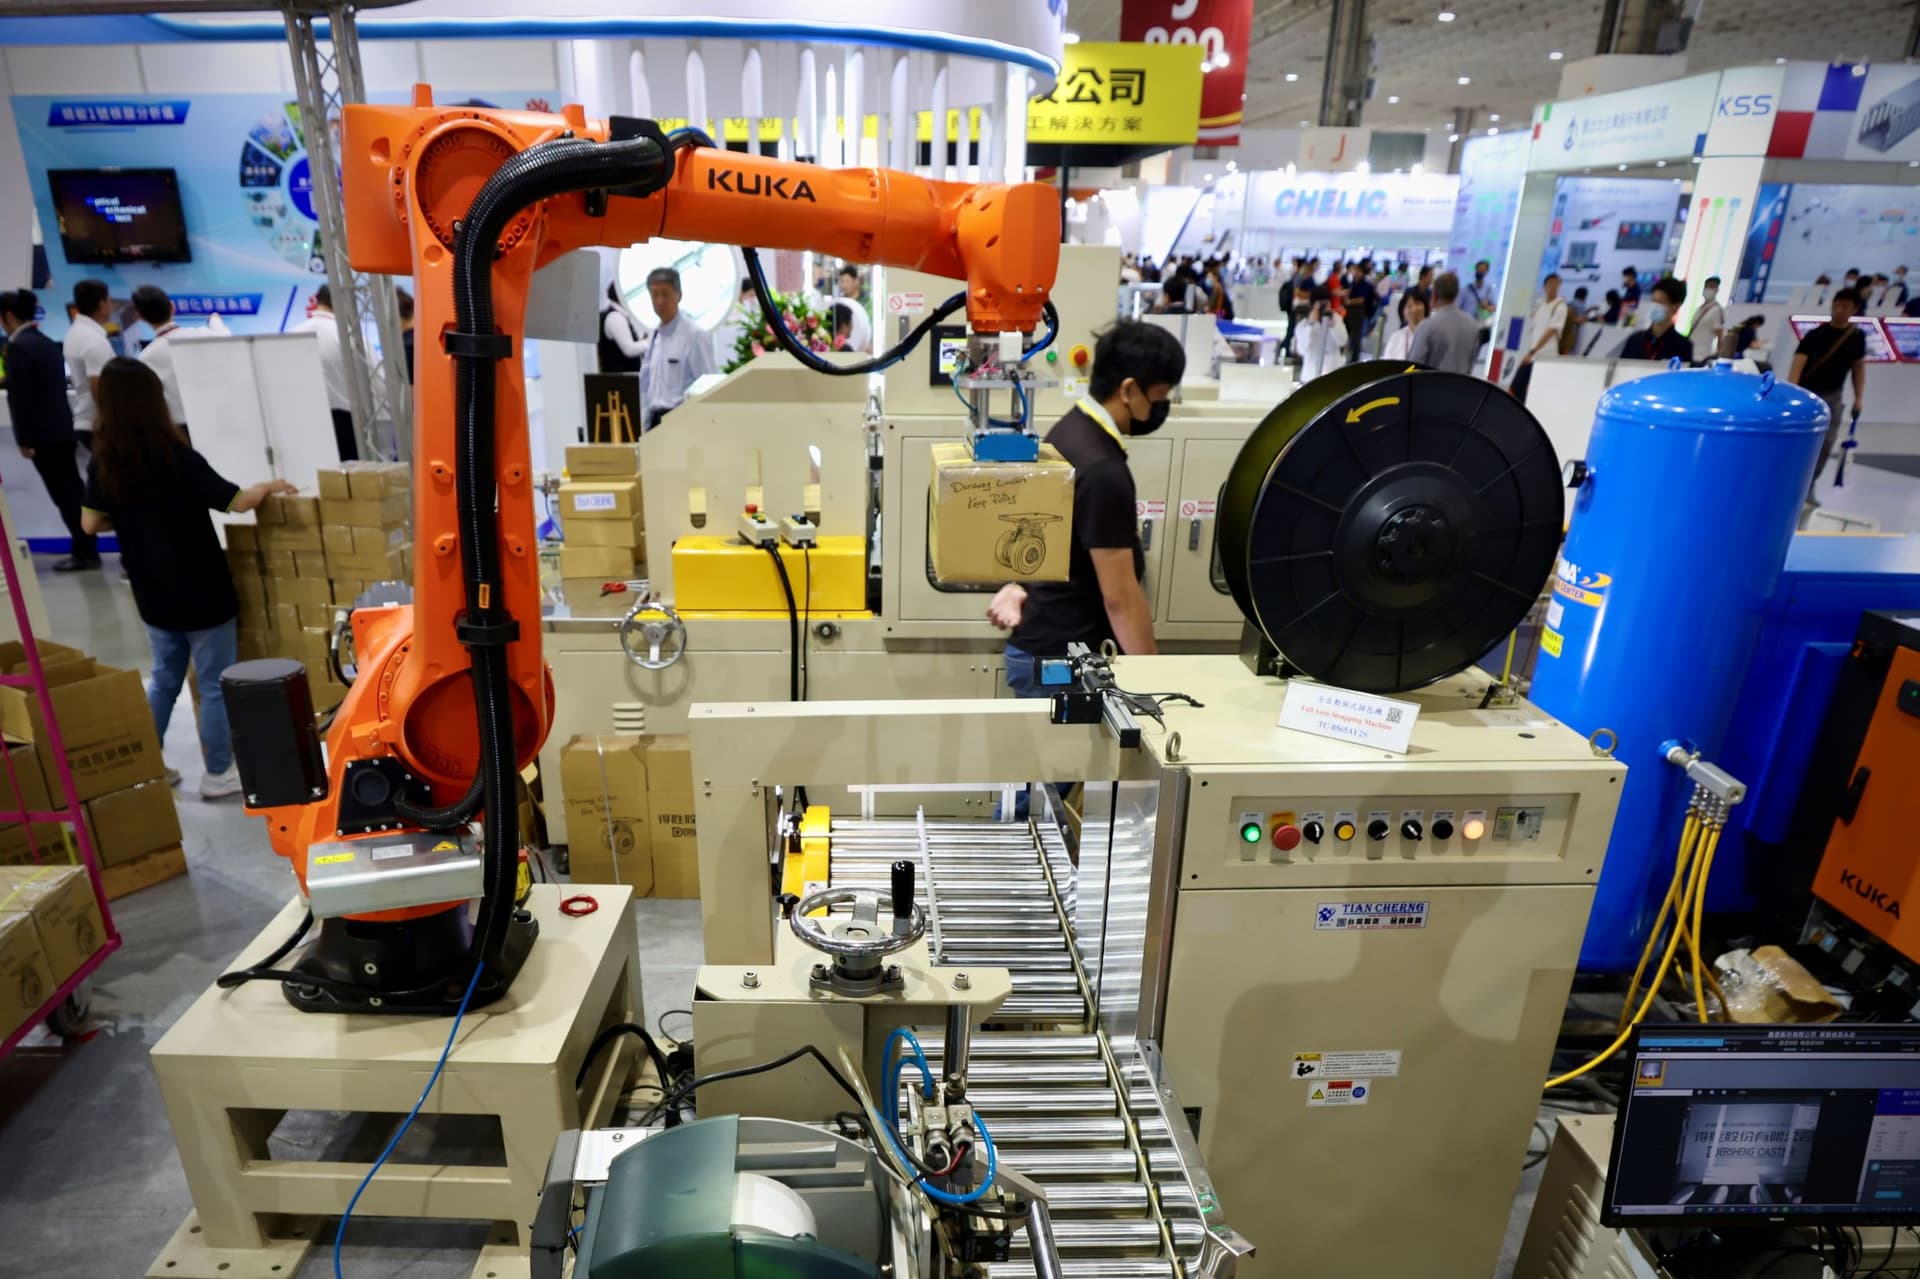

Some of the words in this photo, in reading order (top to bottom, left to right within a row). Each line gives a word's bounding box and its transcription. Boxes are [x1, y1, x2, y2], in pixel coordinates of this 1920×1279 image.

[1717, 95, 1773, 117] KSS
[708, 167, 817, 203] KUKA
[1364, 719, 1393, 731] Machine
[1841, 869, 1901, 919] KUKA
[1343, 904, 1373, 913] TIAN
[1375, 903, 1424, 913] CHERNG
